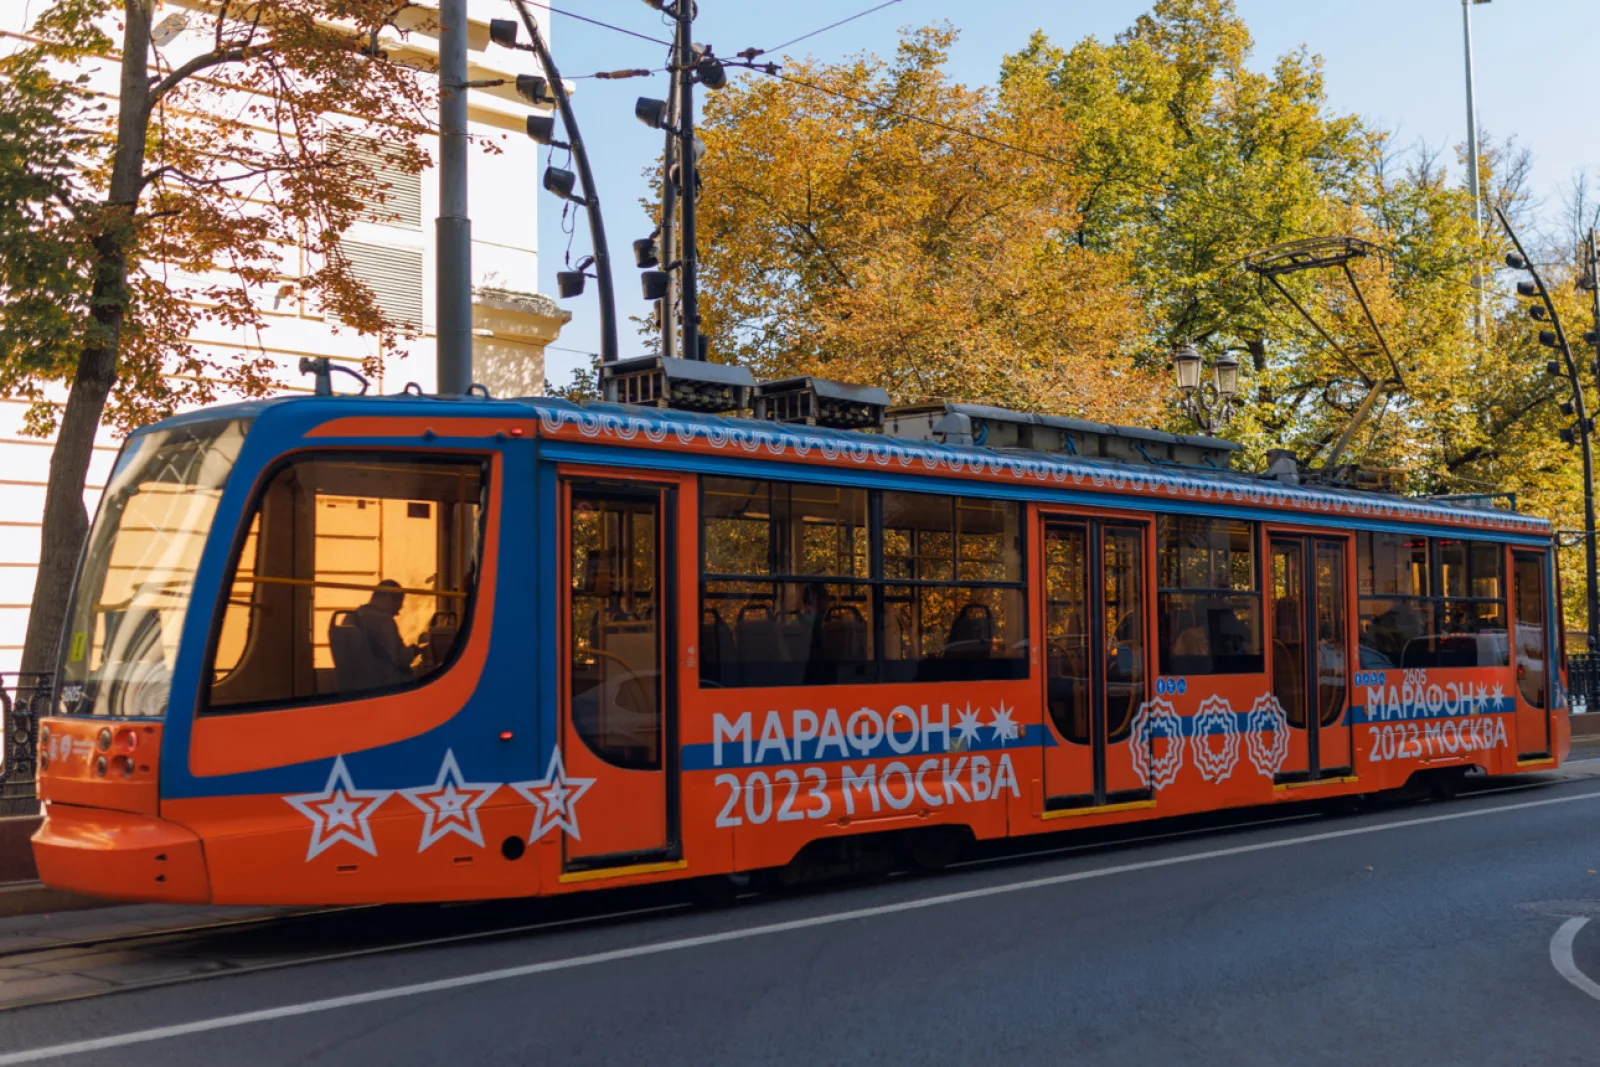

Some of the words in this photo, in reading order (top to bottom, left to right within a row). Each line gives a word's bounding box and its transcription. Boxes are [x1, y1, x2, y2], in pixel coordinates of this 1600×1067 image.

[1403, 668, 1428, 685] 2605
[1367, 682, 1474, 721] МАРАФОН
[713, 704, 949, 766] МАРАФОН
[1369, 722, 1422, 761] 2023
[1425, 717, 1509, 755] МОСКВА
[715, 767, 831, 828] 2023
[842, 754, 1020, 815] МОСКВА
